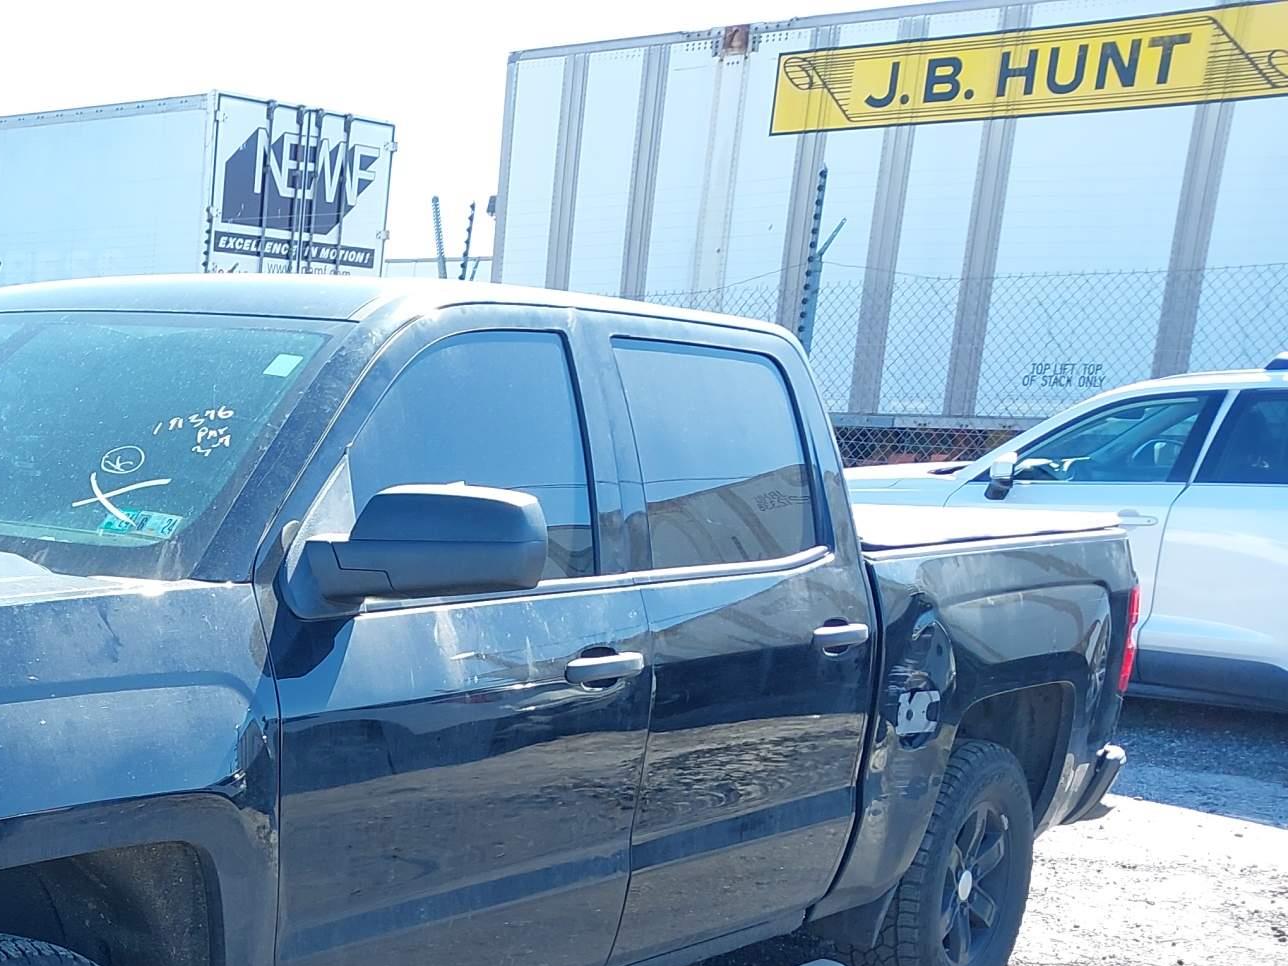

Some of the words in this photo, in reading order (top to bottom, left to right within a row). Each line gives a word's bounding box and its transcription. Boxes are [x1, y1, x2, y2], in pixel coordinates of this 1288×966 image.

[864, 56, 974, 109] J.B.
[996, 33, 1193, 98] HUNT
[319, 248, 371, 265] MOTION!
[1030, 362, 1051, 375] TOP
[1053, 363, 1078, 375] LIFT
[1083, 363, 1104, 376] TOP
[1022, 375, 1037, 387] OF
[1040, 375, 1073, 387] STACK
[1078, 375, 1106, 388] ONLY
[160, 518, 179, 535] 24
